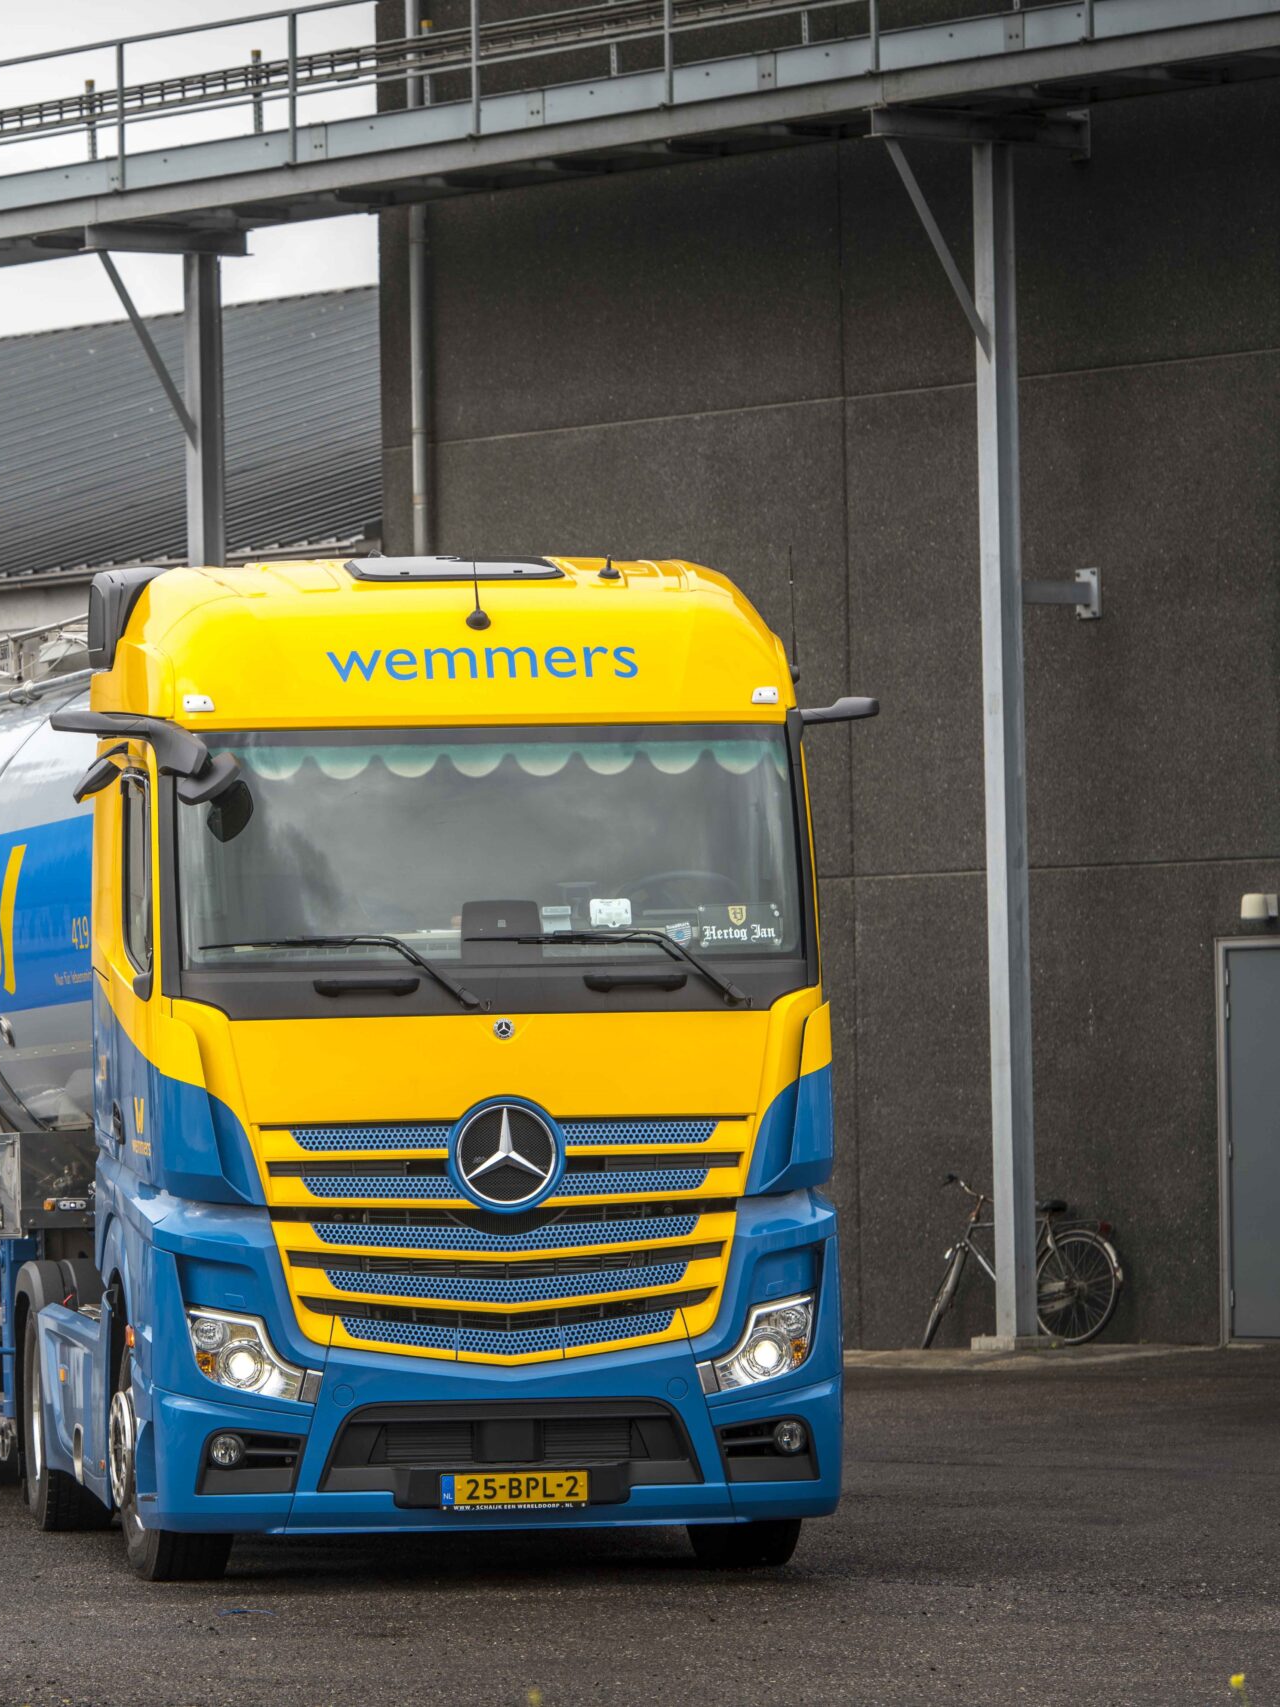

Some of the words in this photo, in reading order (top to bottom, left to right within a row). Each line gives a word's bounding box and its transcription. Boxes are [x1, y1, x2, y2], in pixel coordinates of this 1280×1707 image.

[326, 646, 639, 683] wemmers
[72, 916, 89, 950] 419
[703, 926, 748, 944] Hertog
[751, 924, 775, 942] Jan
[466, 1475, 579, 1500] 25-BPL-2
